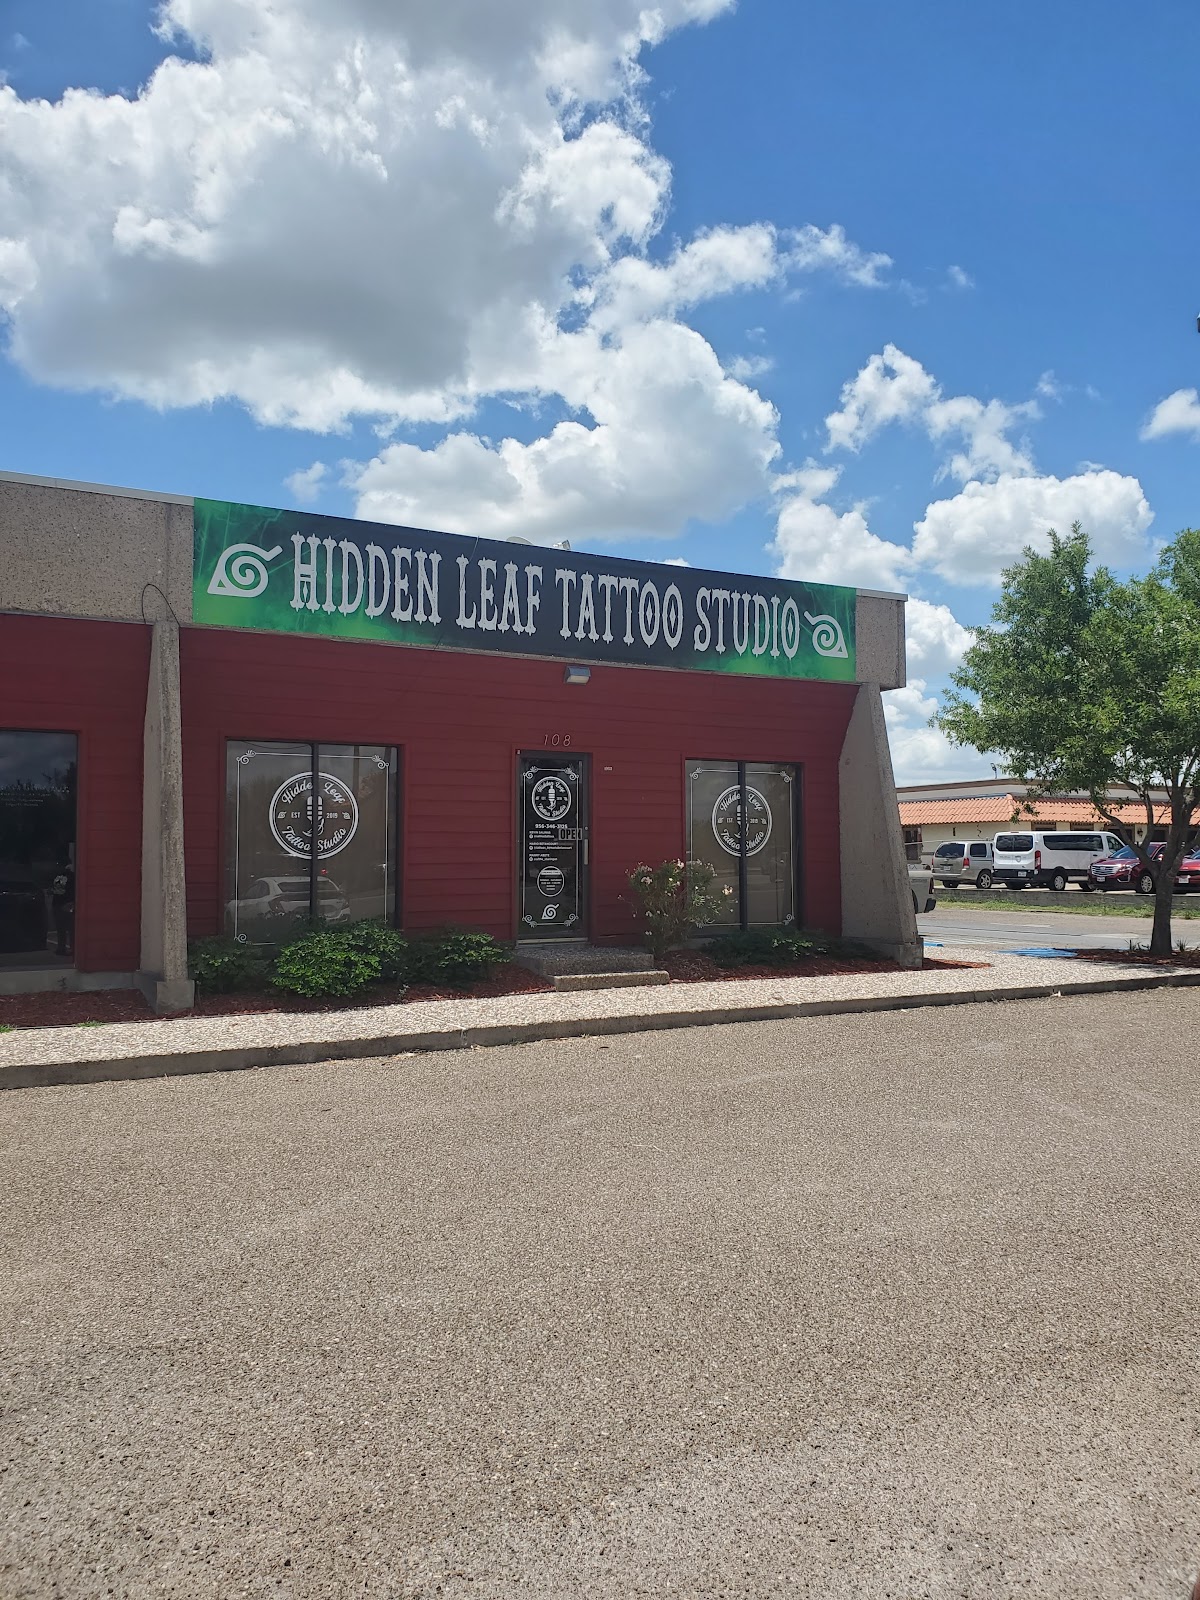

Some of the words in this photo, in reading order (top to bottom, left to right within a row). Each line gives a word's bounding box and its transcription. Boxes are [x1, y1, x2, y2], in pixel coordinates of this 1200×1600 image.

[290, 531, 442, 626] HIDDEN
[455, 554, 543, 636] LEAF
[555, 568, 684, 650] TATTOO
[694, 586, 800, 660] STUDIO
[544, 734, 571, 746] 108
[281, 780, 313, 804] Hidde
[323, 781, 346, 804] Leaf
[720, 791, 741, 811] Hidde
[748, 793, 764, 811] Leaf
[281, 825, 312, 851] Tattoo
[317, 828, 347, 852] Studio
[720, 828, 741, 850] Tattoo
